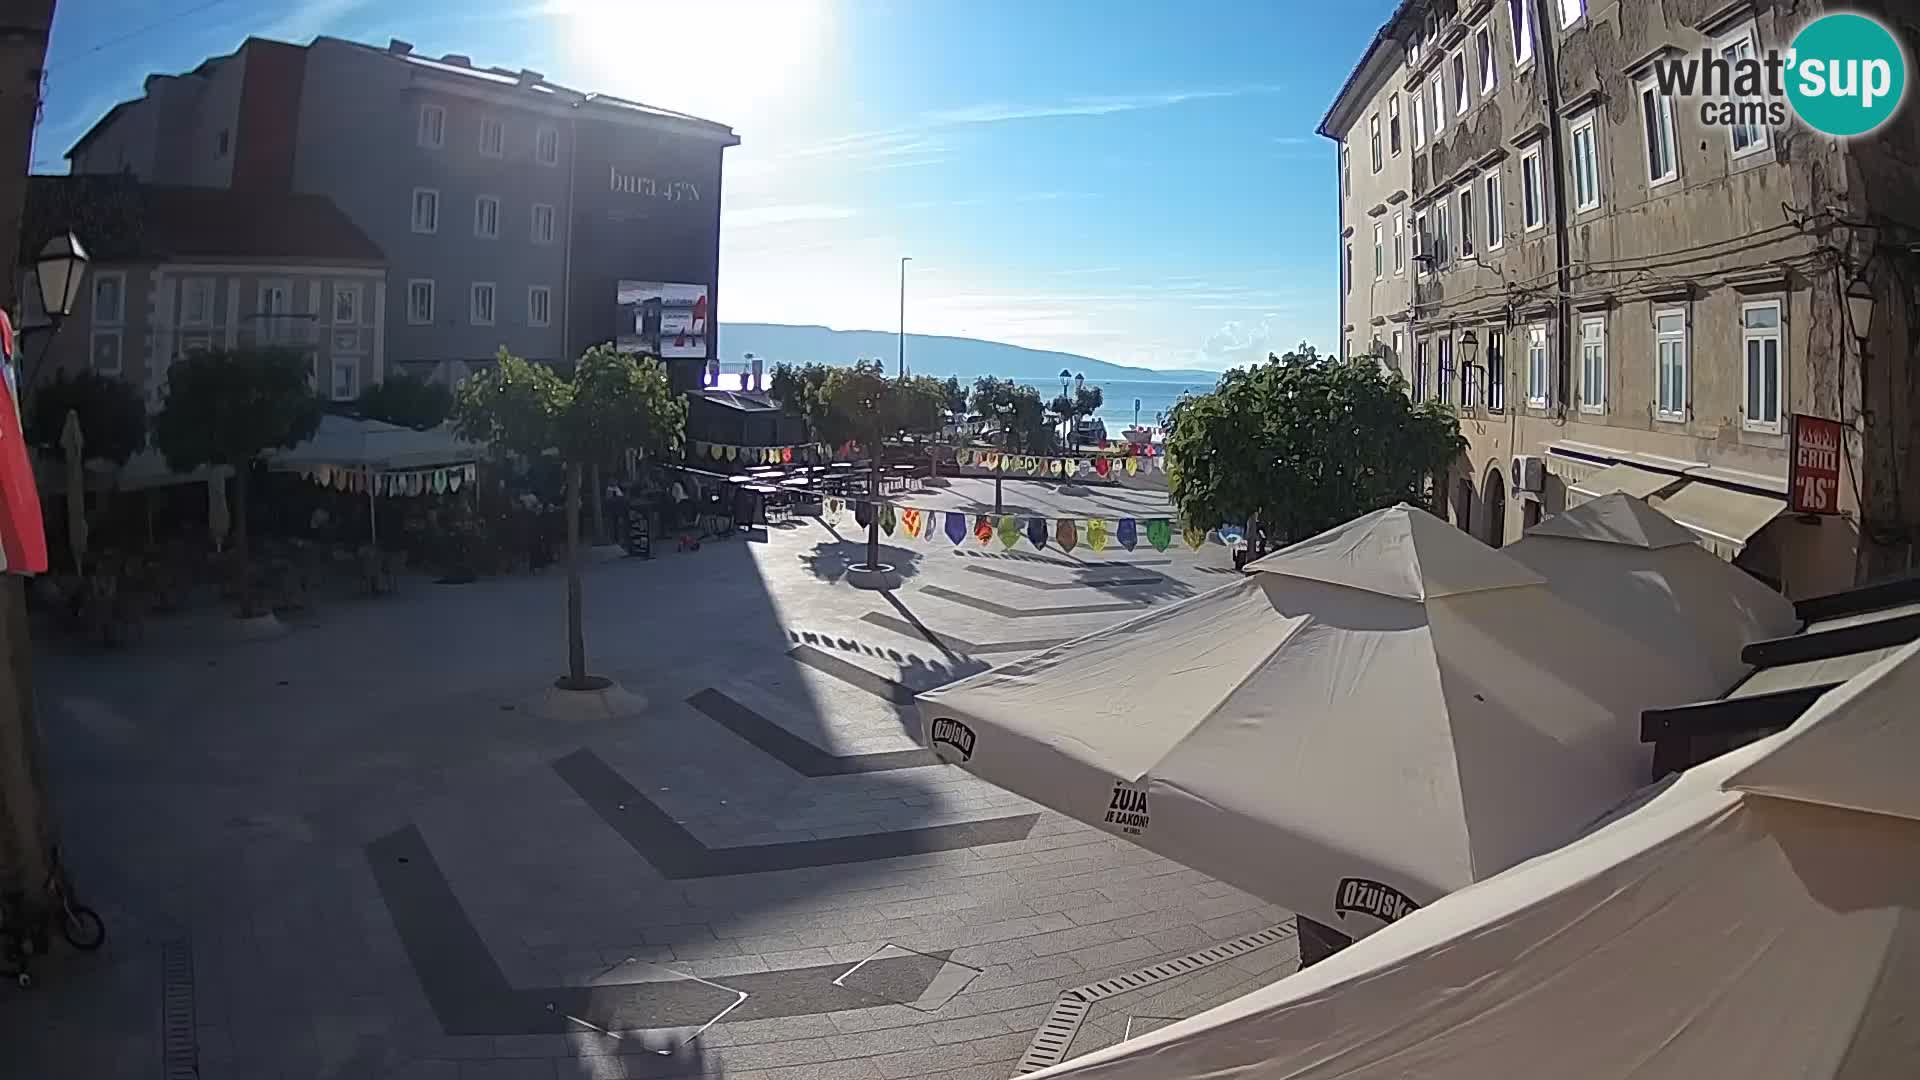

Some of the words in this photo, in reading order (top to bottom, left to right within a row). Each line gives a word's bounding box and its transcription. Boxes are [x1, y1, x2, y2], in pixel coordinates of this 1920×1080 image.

[609, 164, 657, 197] bura
[1798, 447, 1838, 471] GRILL
[934, 719, 972, 753] Ožujsko
[1109, 780, 1148, 814] ŽUJA
[1104, 810, 1115, 823] JE
[1115, 811, 1150, 829] ZAKON!
